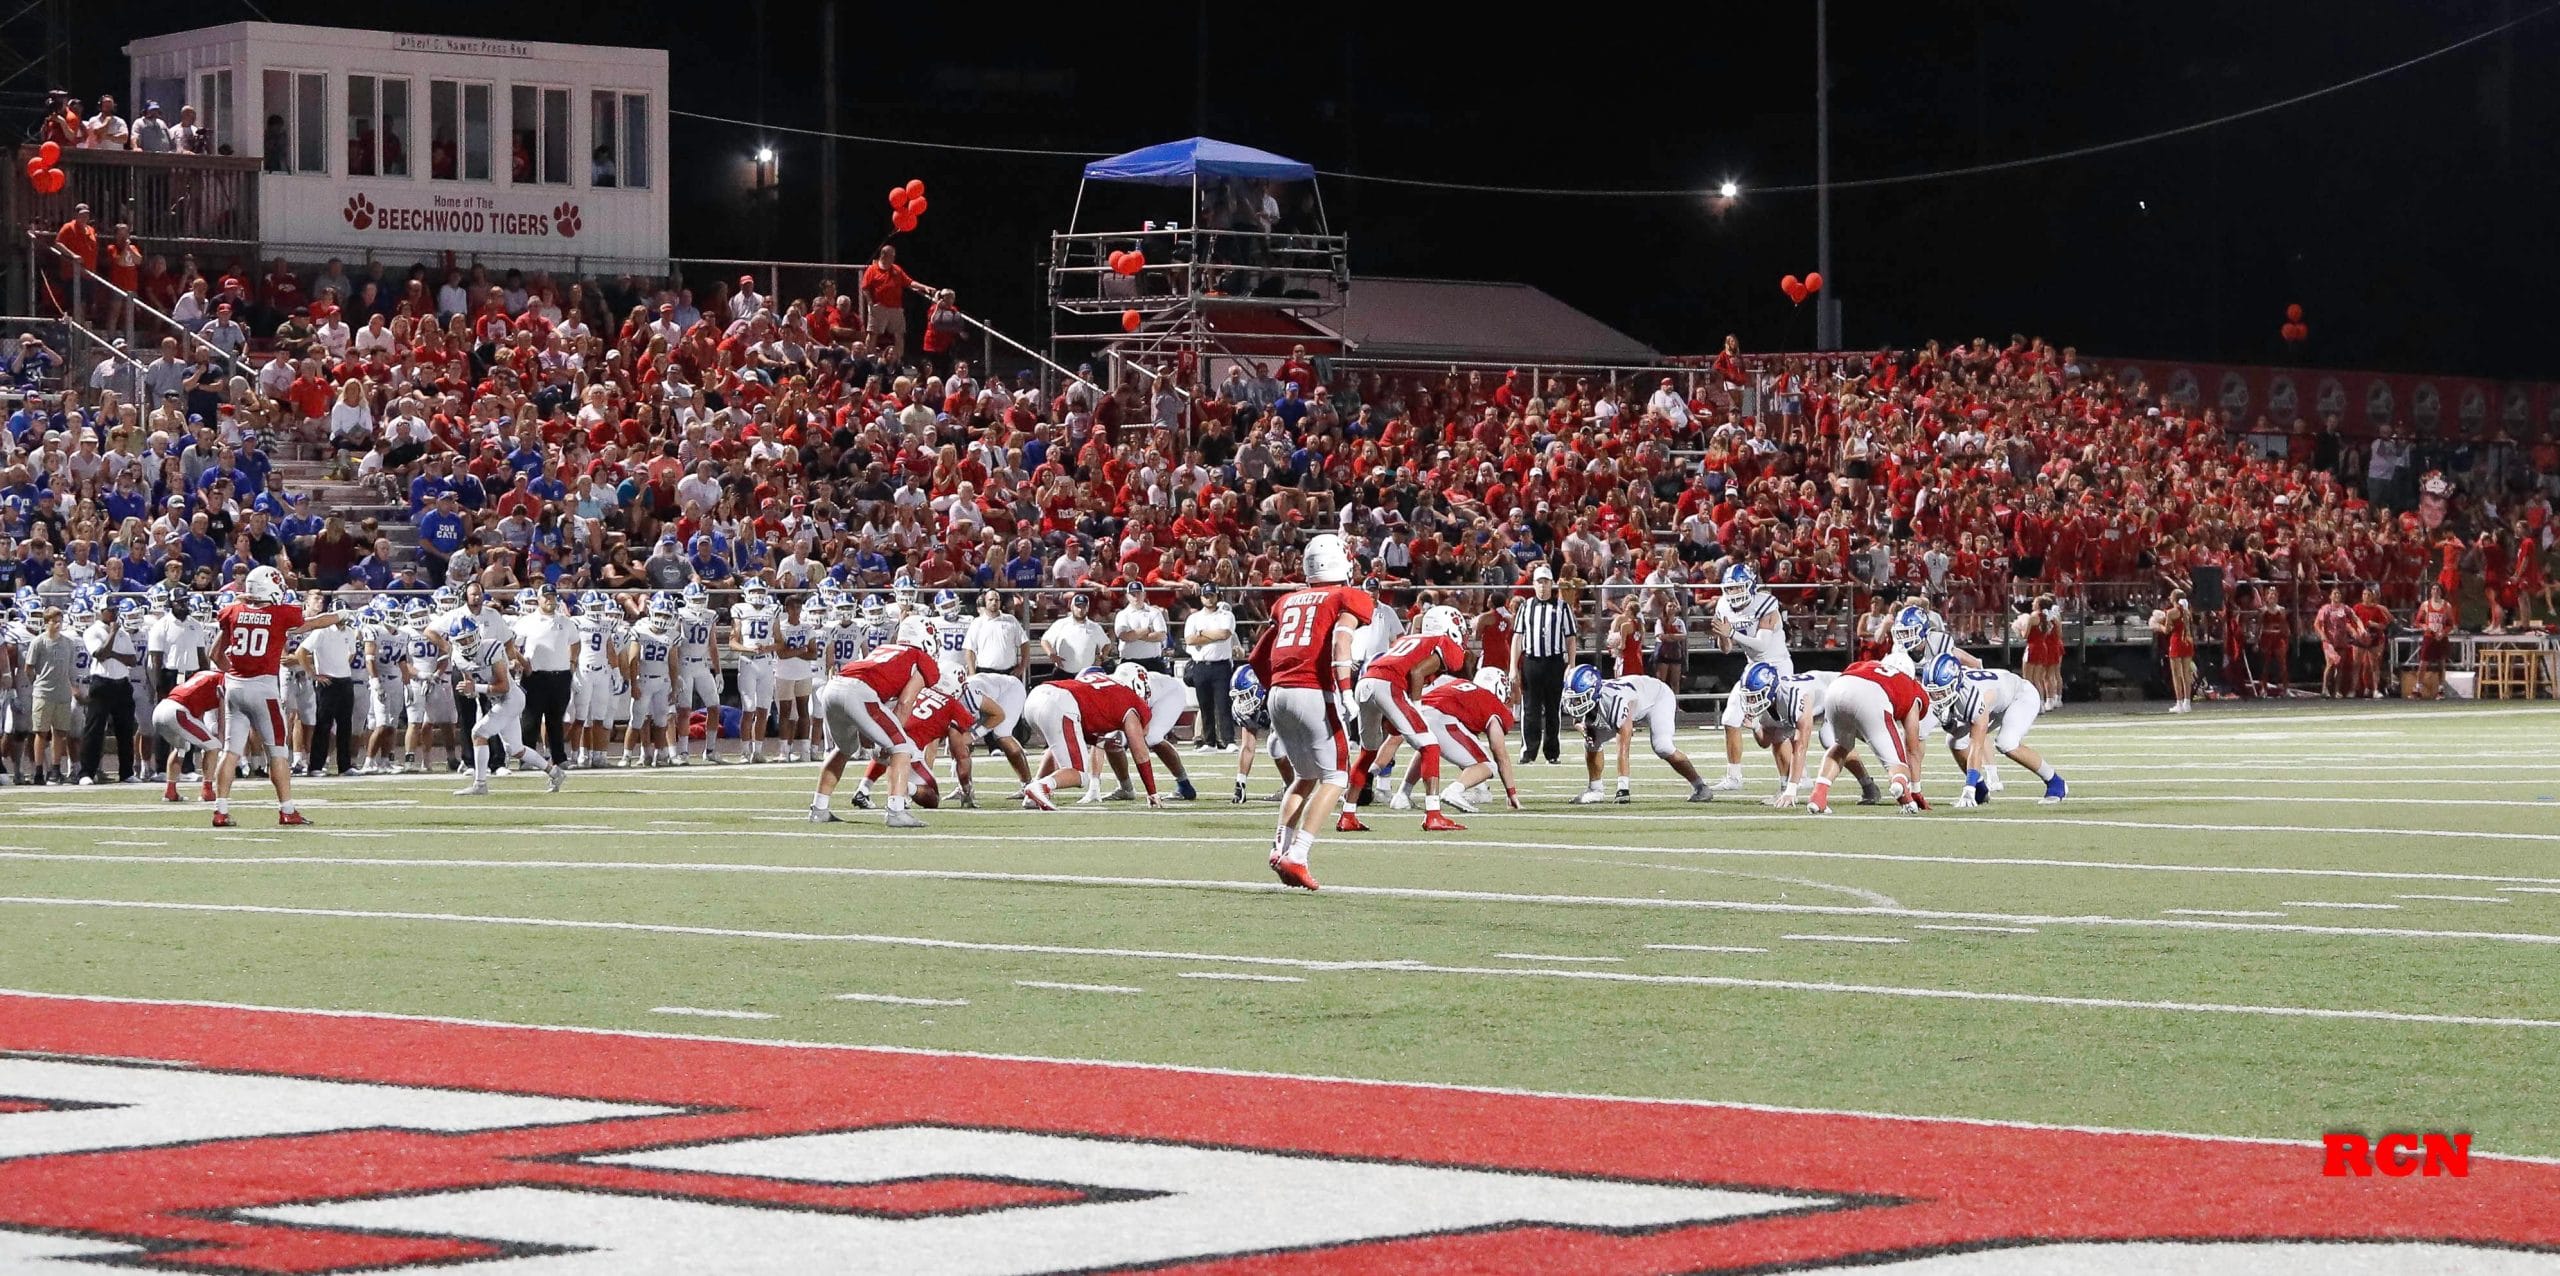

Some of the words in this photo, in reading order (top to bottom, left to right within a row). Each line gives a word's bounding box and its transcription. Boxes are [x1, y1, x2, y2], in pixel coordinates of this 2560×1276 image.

[434, 195, 461, 207] Home
[463, 197, 473, 208] of
[476, 197, 494, 209] The
[378, 208, 484, 233] BEECHWOOD
[489, 212, 549, 236] TIGERS
[237, 611, 272, 626] BERGER
[1276, 606, 1317, 648] 21
[688, 624, 708, 645] 10
[748, 620, 769, 639] 15
[232, 627, 269, 657] 30
[414, 641, 438, 659] 30
[591, 632, 602, 652] 9
[943, 632, 965, 651] 58
[644, 643, 668, 662] 22
